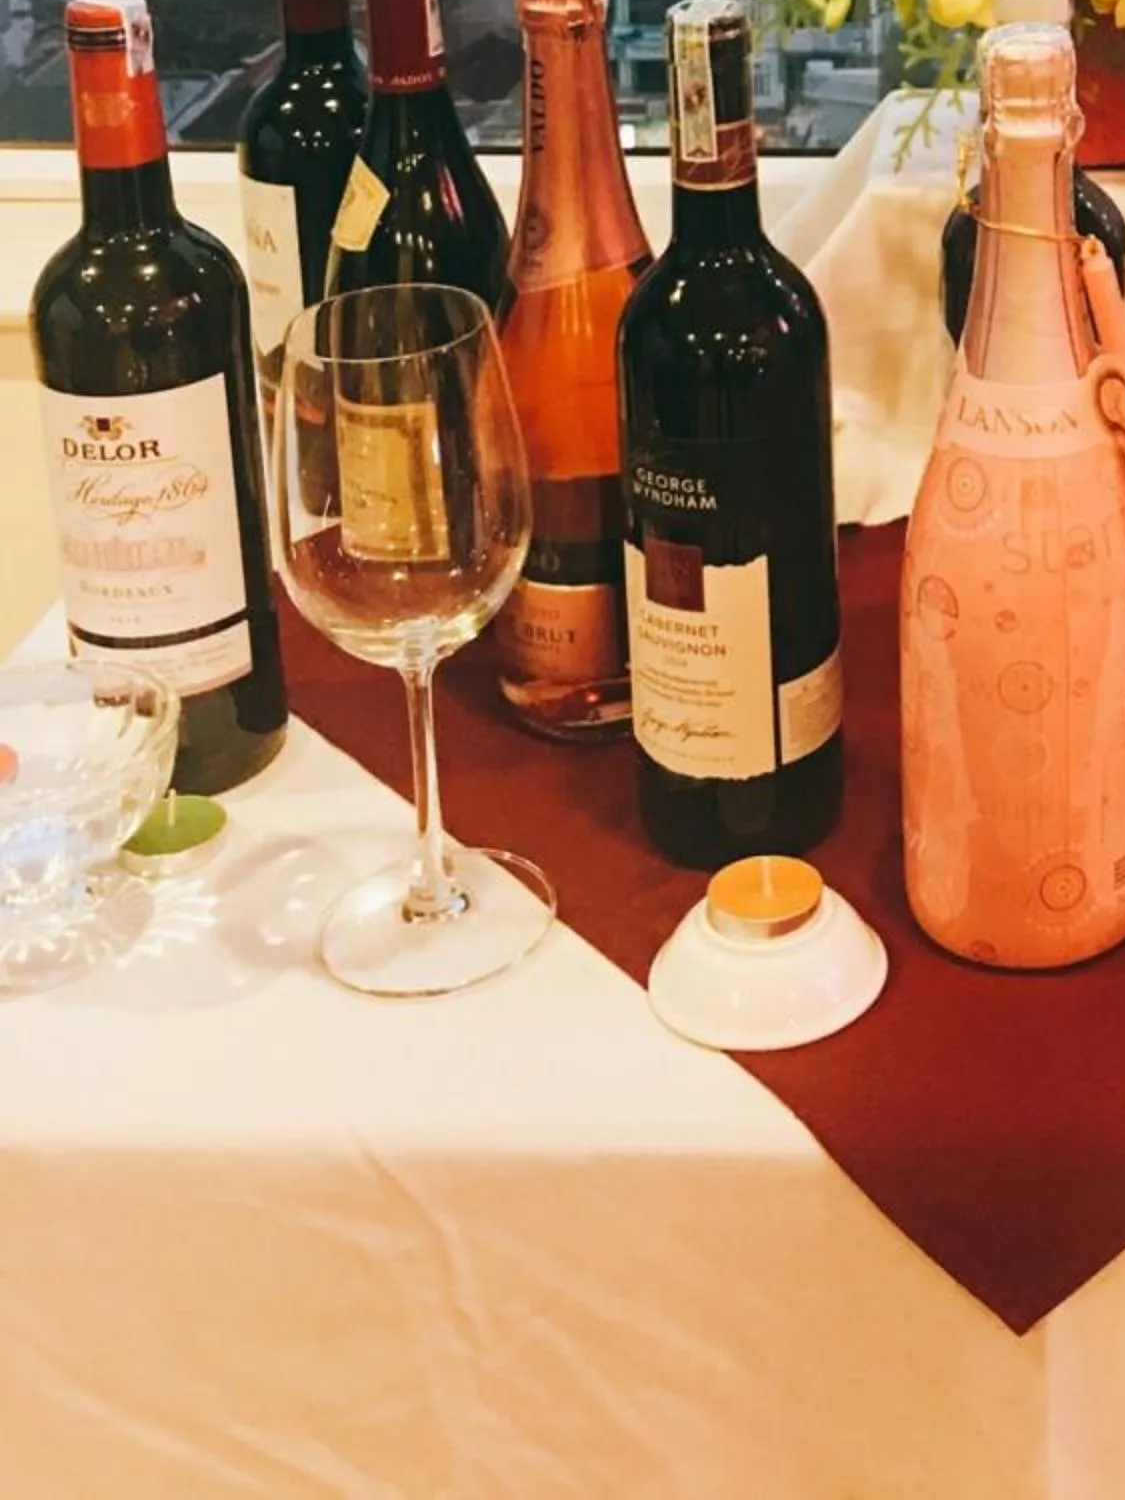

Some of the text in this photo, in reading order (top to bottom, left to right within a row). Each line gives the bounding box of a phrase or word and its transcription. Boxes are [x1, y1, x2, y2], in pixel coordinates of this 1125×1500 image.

[62, 436, 162, 462] DELOR
[635, 466, 707, 494] GEORGE
[633, 481, 718, 511] WYNDHAM
[523, 621, 576, 645] BRUT
